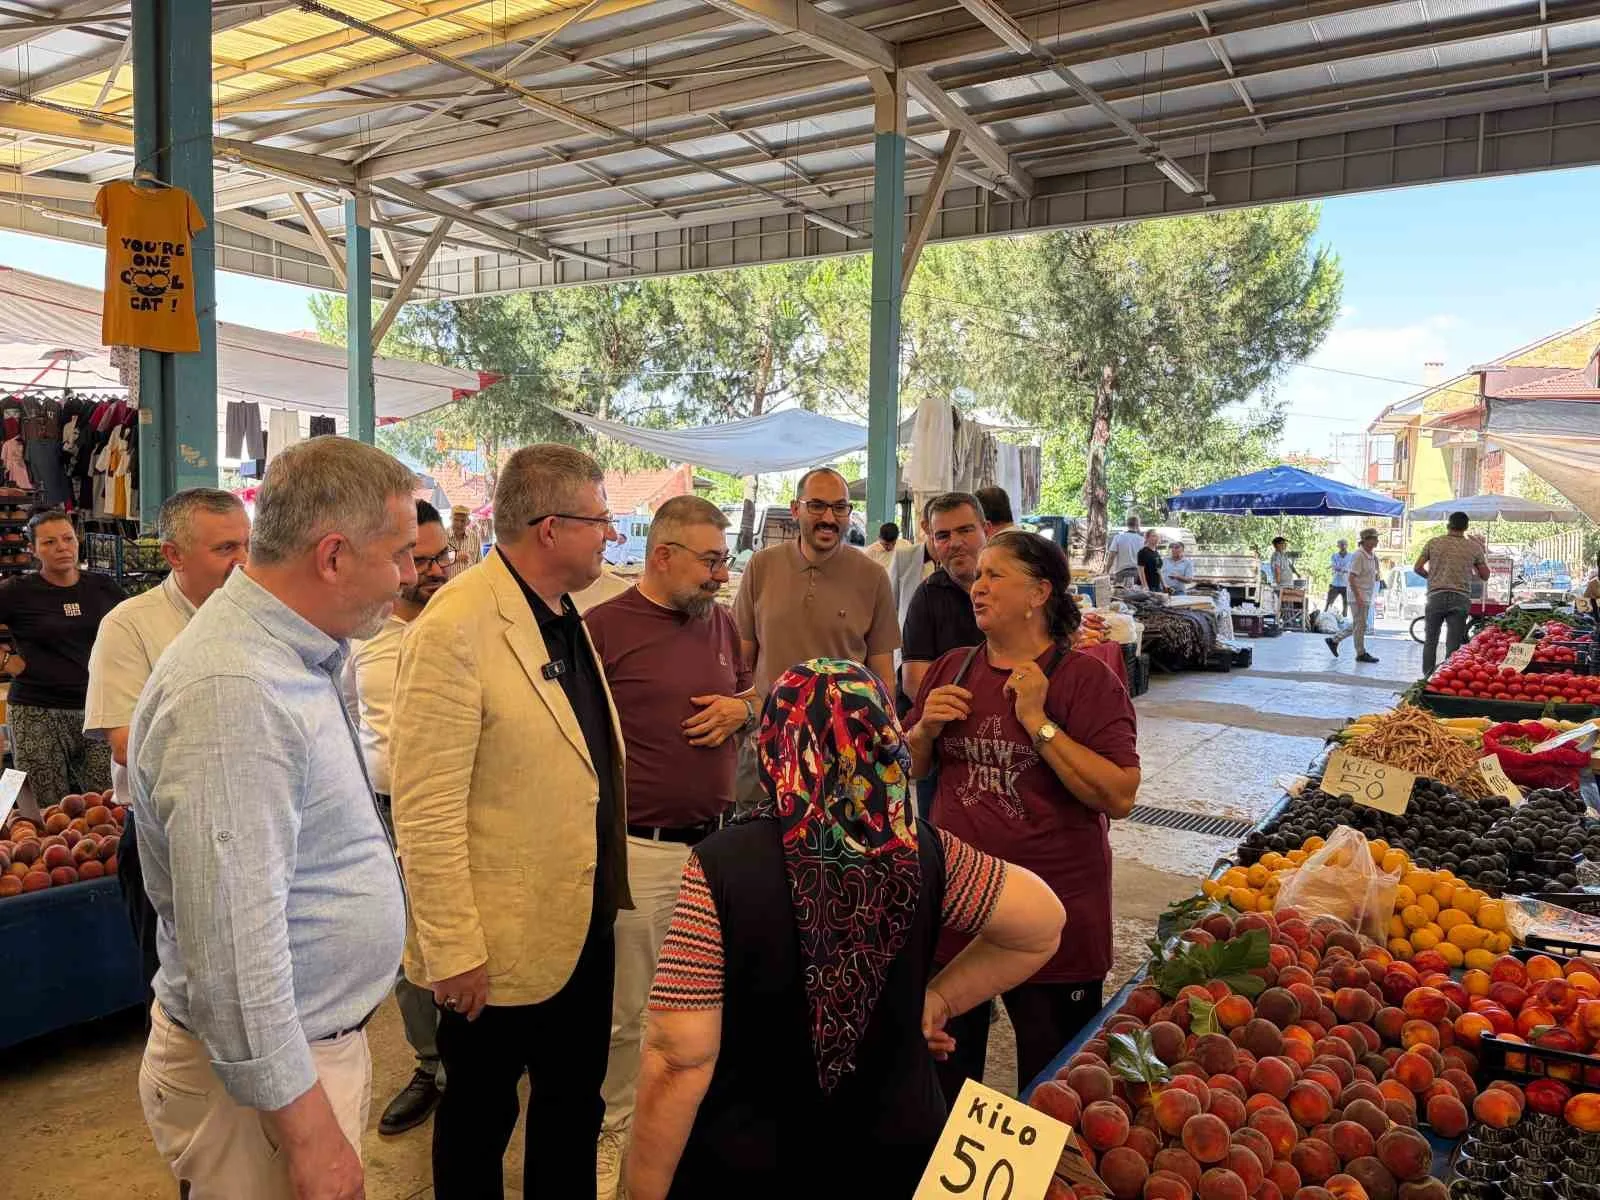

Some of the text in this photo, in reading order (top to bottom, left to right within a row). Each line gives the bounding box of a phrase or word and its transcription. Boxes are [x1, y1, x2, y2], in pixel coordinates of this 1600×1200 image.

[121, 237, 185, 257] YOU'RE
[133, 255, 171, 268] ONE
[964, 736, 1016, 766] NEW
[968, 761, 1021, 799] YORK
[1336, 774, 1384, 800] 50
[939, 1134, 1015, 1200] 50
